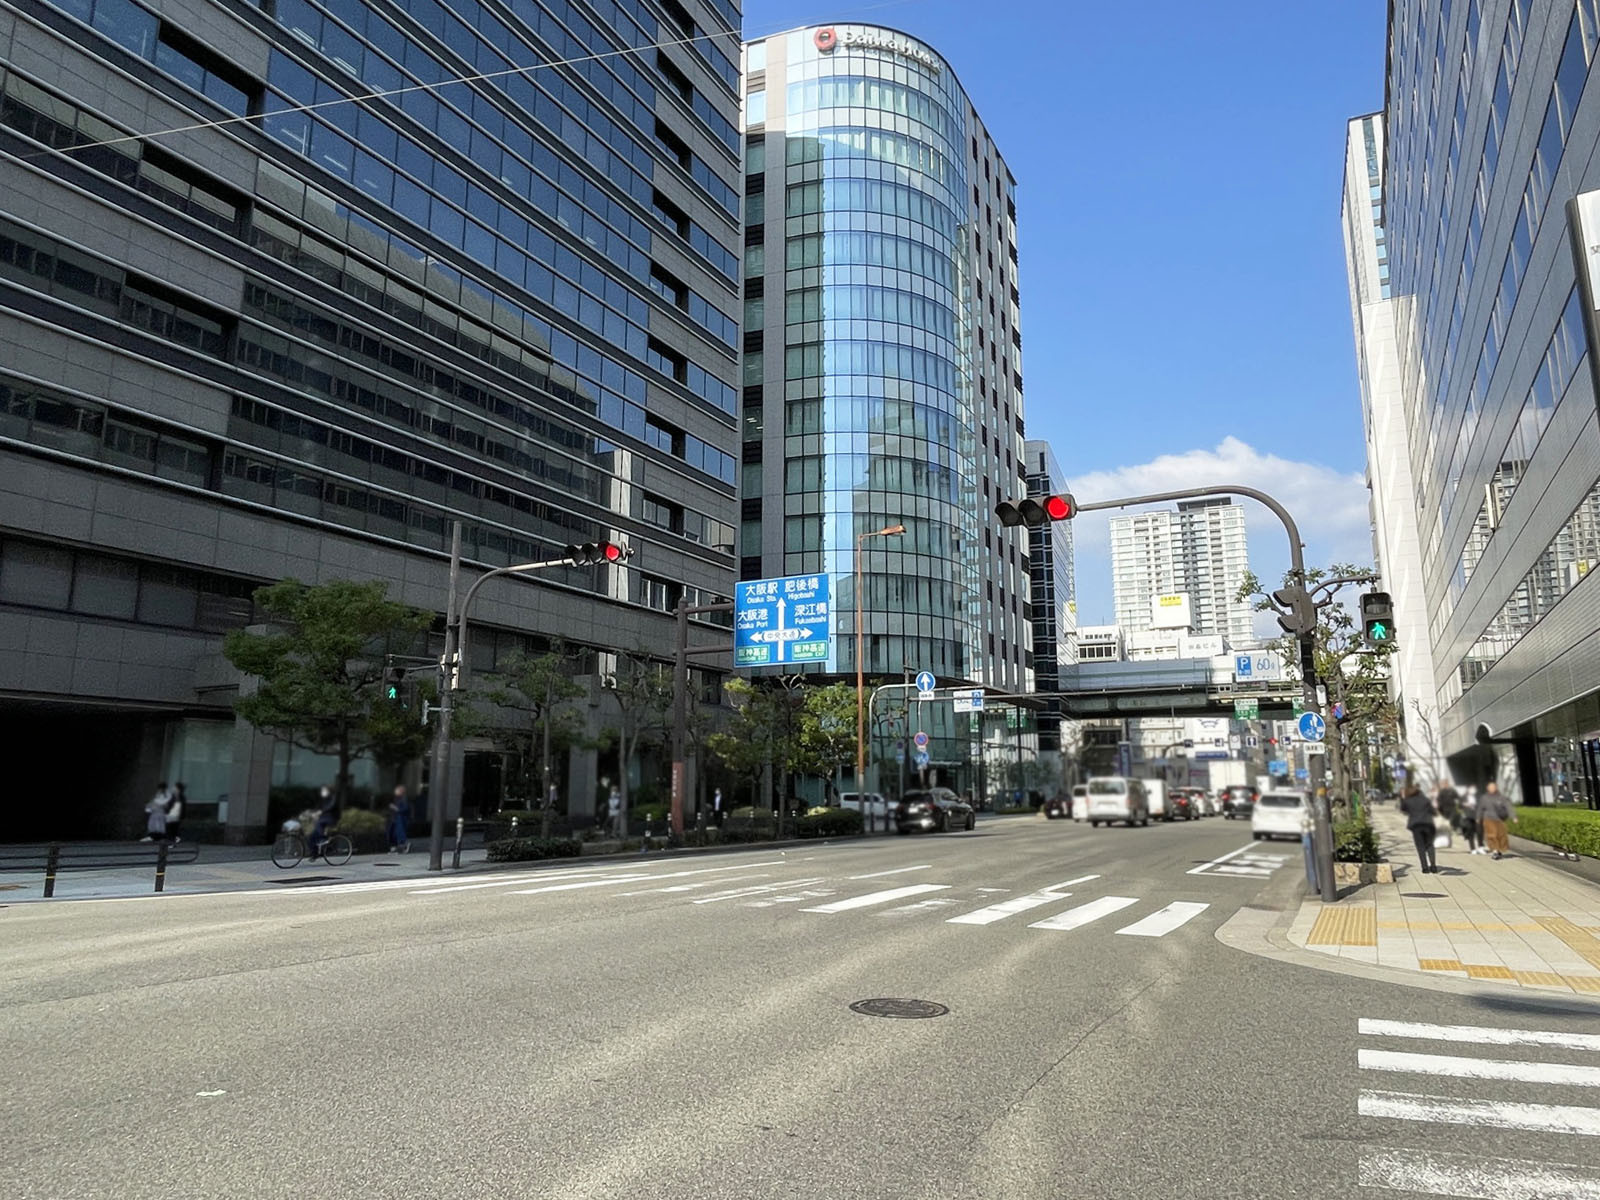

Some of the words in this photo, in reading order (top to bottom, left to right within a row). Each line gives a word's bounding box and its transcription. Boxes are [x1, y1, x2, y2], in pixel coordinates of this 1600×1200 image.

[745, 582, 778, 596] 大阪駅
[784, 577, 819, 592] 肥後橋
[737, 608, 768, 622] 大阪港
[794, 602, 827, 617] 深江橋
[1240, 657, 1248, 670] P
